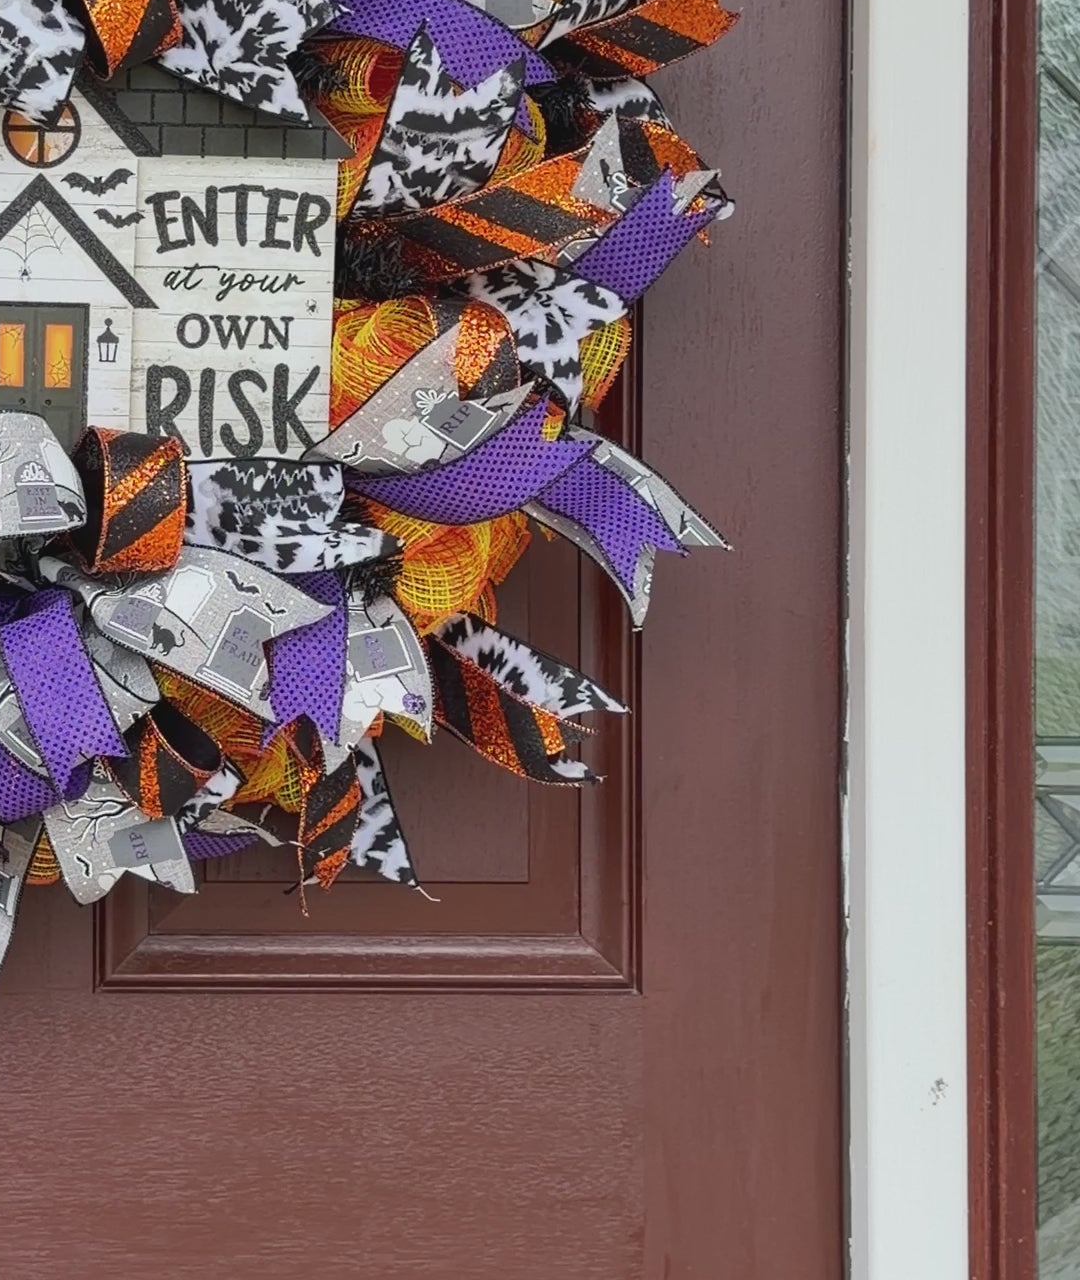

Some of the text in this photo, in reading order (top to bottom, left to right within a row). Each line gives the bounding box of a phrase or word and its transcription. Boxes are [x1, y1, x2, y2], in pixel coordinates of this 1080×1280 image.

[144, 183, 331, 258] ENTER
[163, 263, 305, 302] at your
[176, 312, 295, 350] OWN
[146, 363, 321, 458] RISK
[440, 404, 472, 434] RIP
[129, 832, 149, 860] RIP
